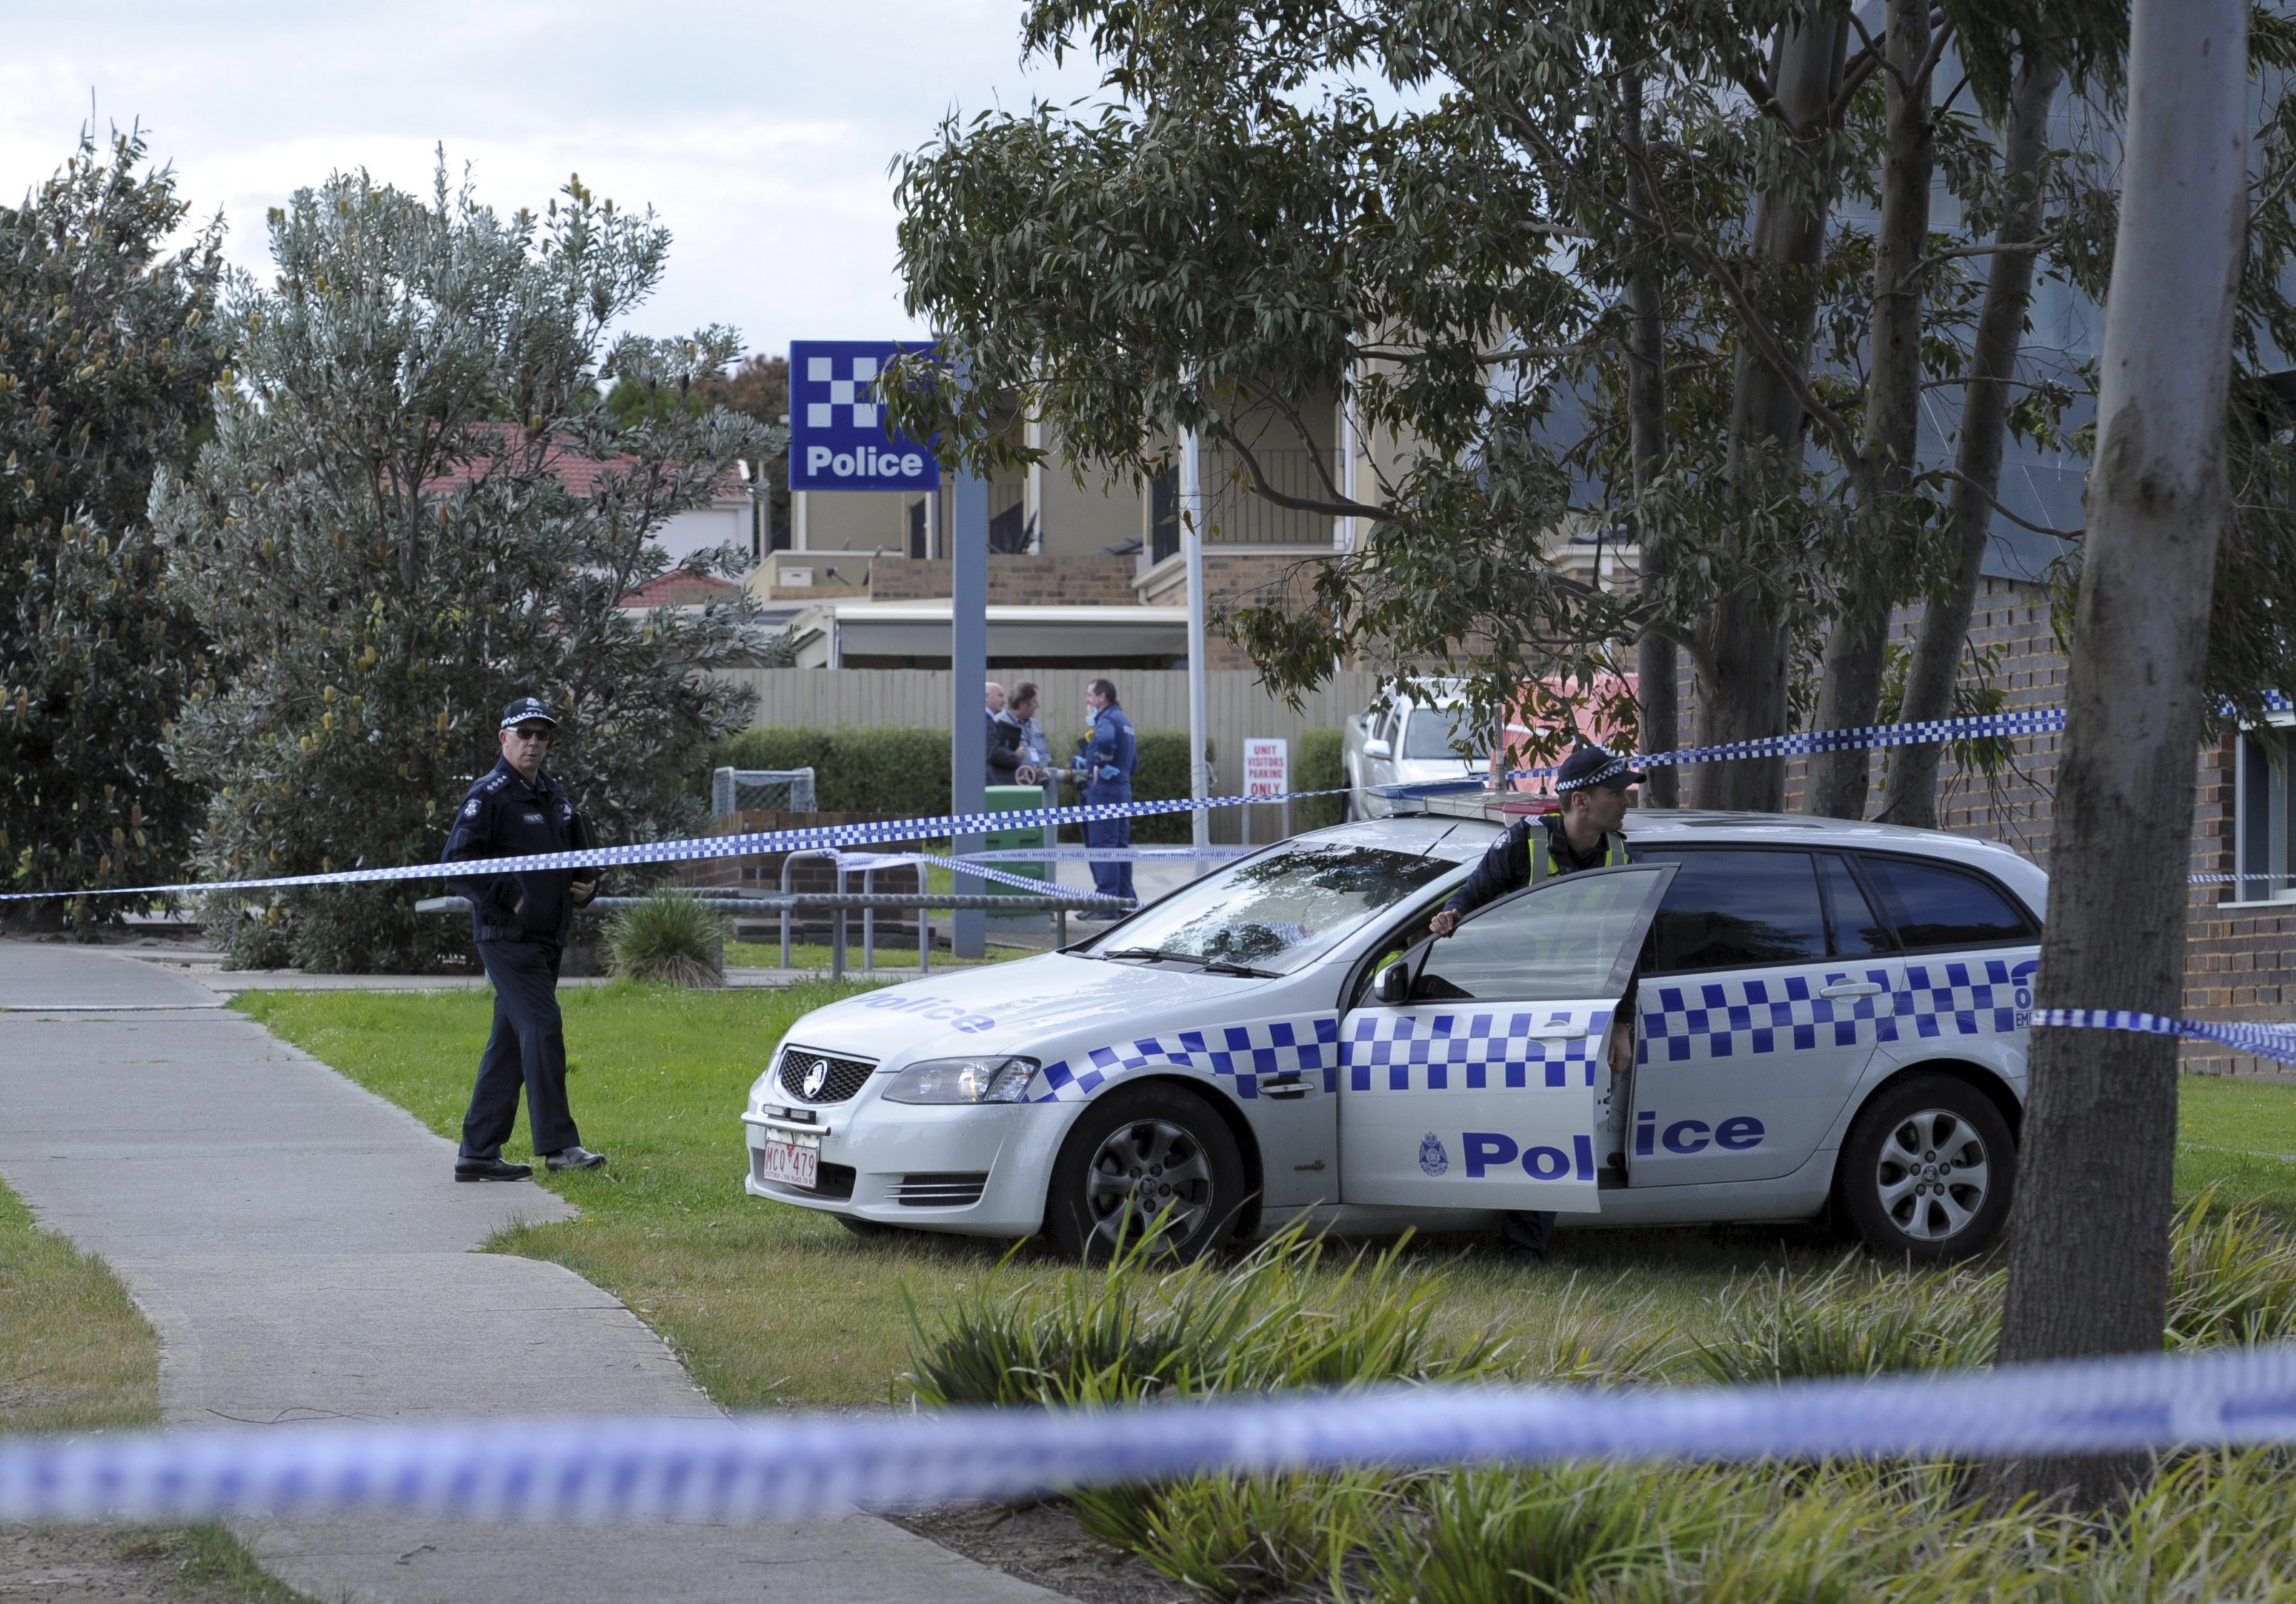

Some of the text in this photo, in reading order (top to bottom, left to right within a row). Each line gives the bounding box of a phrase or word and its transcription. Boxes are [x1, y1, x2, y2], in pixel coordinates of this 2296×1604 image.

[807, 445, 923, 477] Police
[1254, 746, 1277, 755] UNIT
[1247, 756, 1285, 767] VISITORS
[1249, 769, 1282, 778] PARKING
[1251, 783, 1280, 796] ONLY
[766, 1147, 814, 1177] MCQ 479
